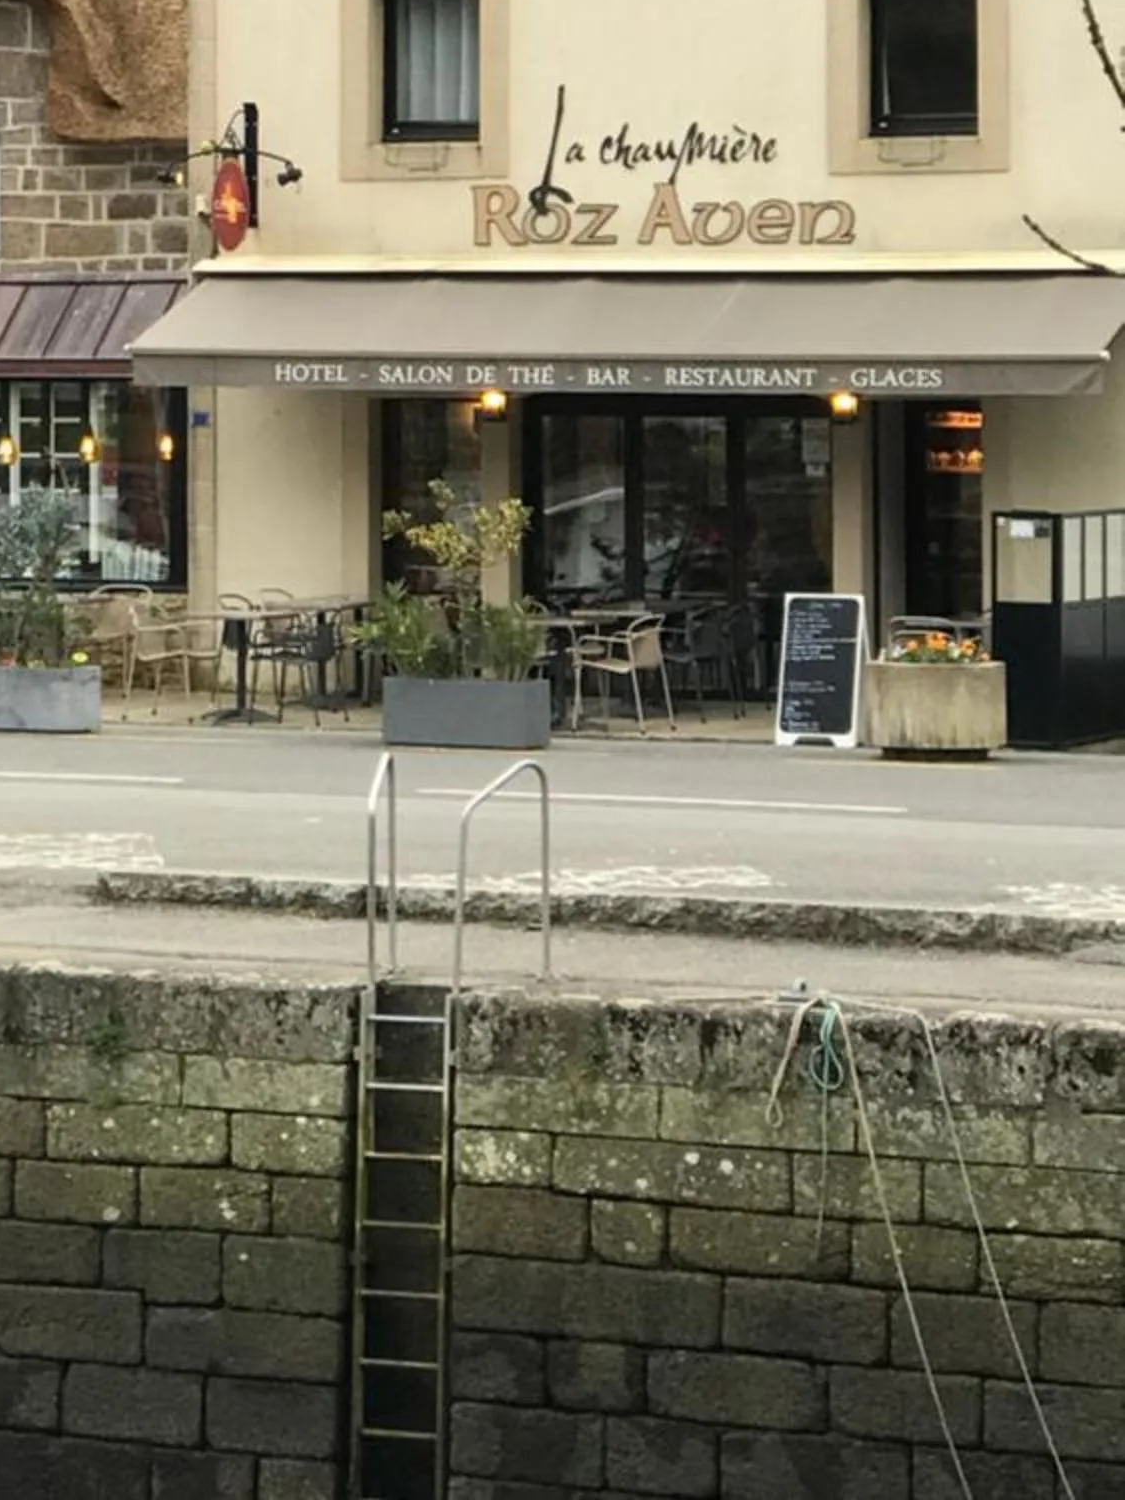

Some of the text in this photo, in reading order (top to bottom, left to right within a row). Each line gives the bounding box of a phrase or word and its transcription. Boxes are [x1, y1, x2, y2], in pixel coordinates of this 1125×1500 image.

[470, 182, 856, 247] Roz Aven
[275, 364, 348, 383] HOTEL
[378, 365, 453, 384] SALON
[467, 365, 496, 384] DE
[587, 367, 631, 386] BAR
[665, 367, 817, 387] RESTAURANT
[850, 368, 943, 388] GLACES
